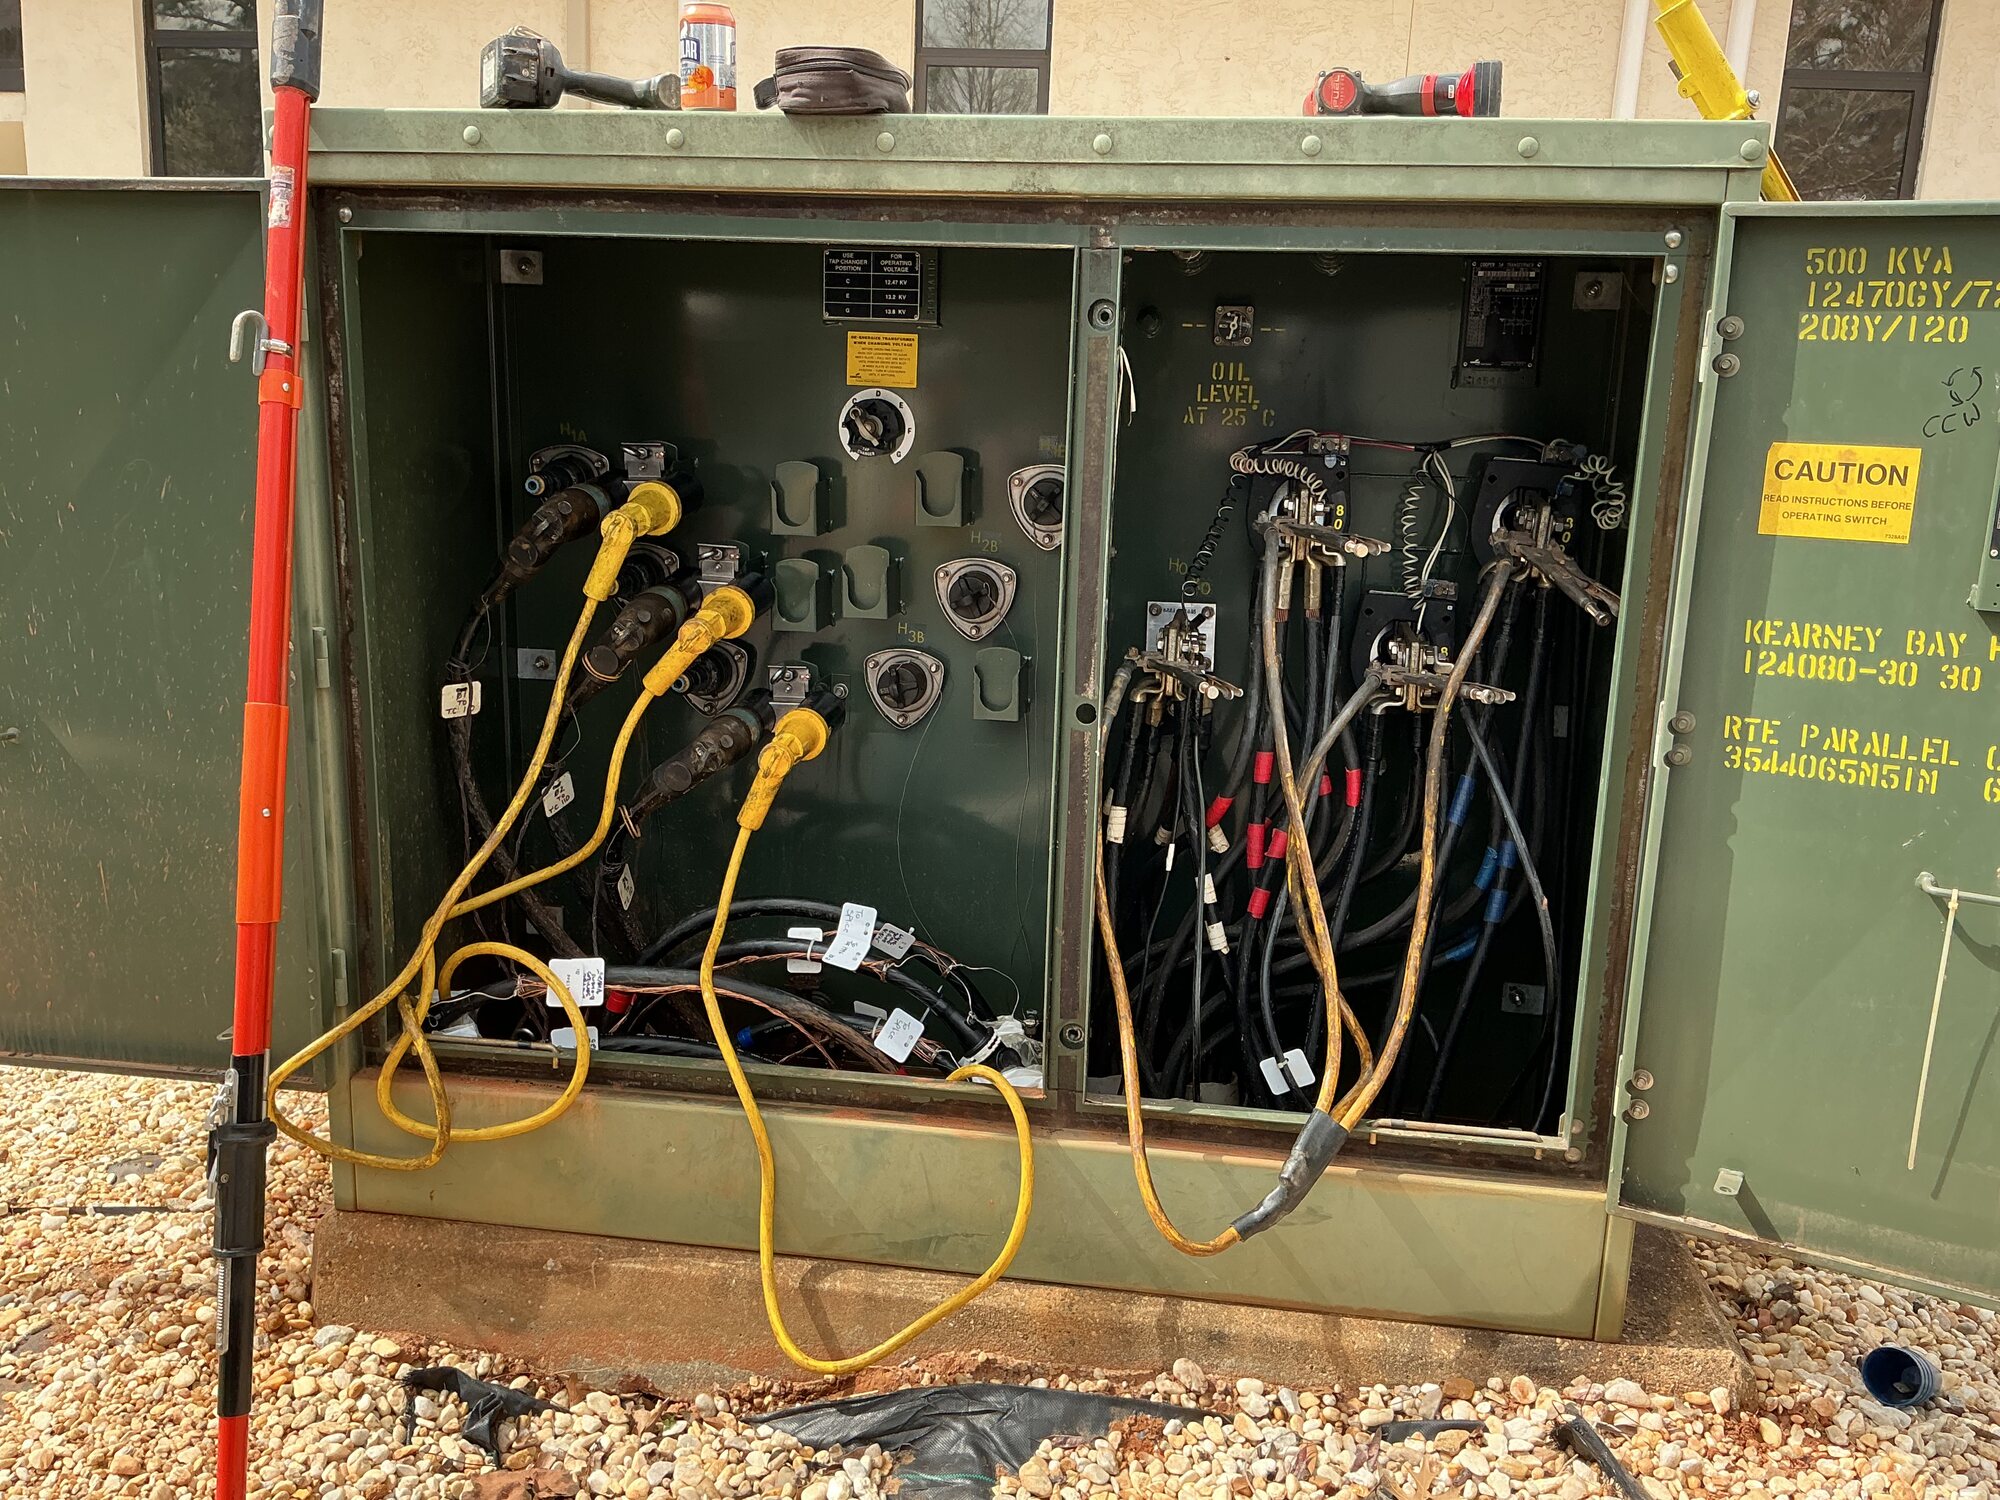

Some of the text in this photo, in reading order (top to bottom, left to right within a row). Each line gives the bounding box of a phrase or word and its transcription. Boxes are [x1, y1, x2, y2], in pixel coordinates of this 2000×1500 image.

[1332, 74, 1341, 109] FUEL
[1806, 246, 1953, 275] 500 KVA
[1799, 313, 1969, 343] 208Y/120
[1212, 362, 1250, 381] OIL
[851, 397, 858, 405] C
[899, 401, 904, 409] E
[1197, 383, 1260, 404] LEVEL
[1183, 406, 1208, 424] AT
[1922, 402, 1981, 438] CCW
[907, 427, 912, 435] F
[1774, 458, 1909, 487] CAUTION
[1763, 493, 1912, 511] READ INSTRUCTIONS BEFORE
[1782, 510, 1888, 526] OPERATING SWITCH
[970, 530, 998, 553] H2B
[897, 621, 925, 644] H3B
[1744, 619, 1884, 653] KEARNEY
[1905, 629, 1968, 659] BAY
[1744, 649, 1982, 692] 124080-30 30
[1724, 715, 1781, 745] RTE
[1800, 723, 1960, 766] PARALLEL
[855, 909, 864, 919] TO
